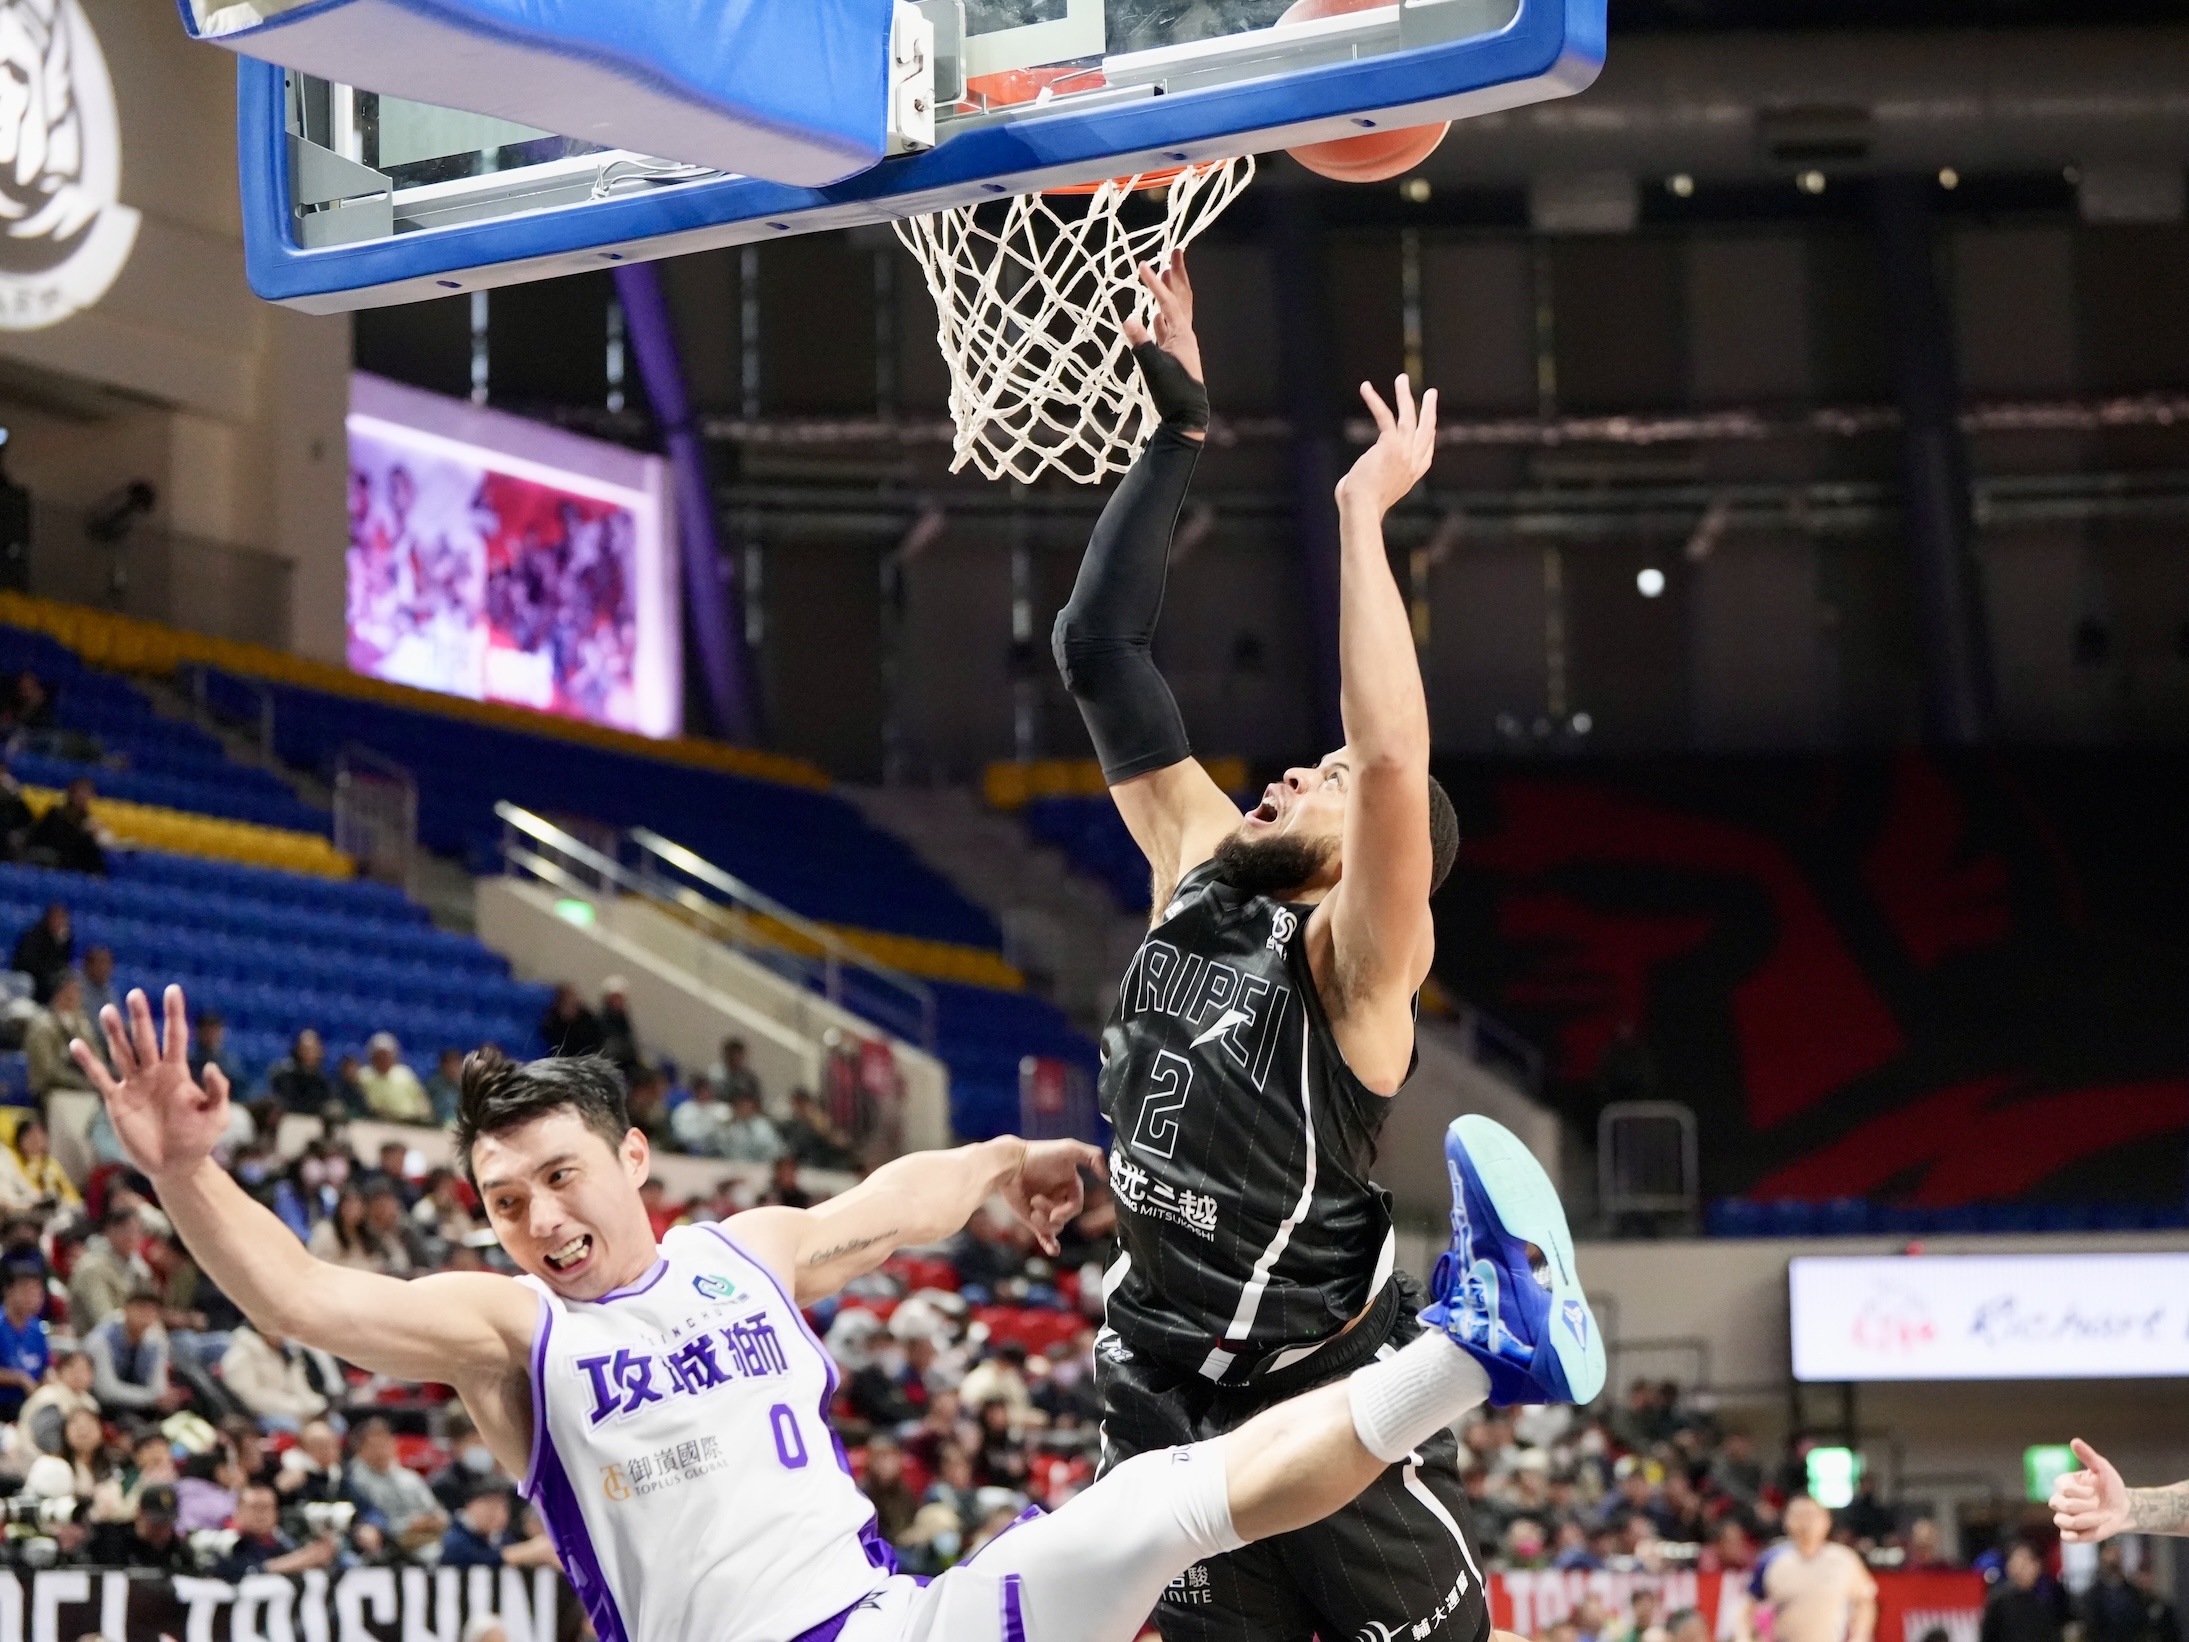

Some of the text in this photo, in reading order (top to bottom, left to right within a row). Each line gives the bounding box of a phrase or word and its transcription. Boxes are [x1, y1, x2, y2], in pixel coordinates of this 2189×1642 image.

[1131, 1049, 1194, 1159] 2
[576, 1312, 789, 1426] 攻城獅
[634, 1459, 729, 1496] TOPLUS GLOBAL
[769, 1403, 808, 1470] 0
